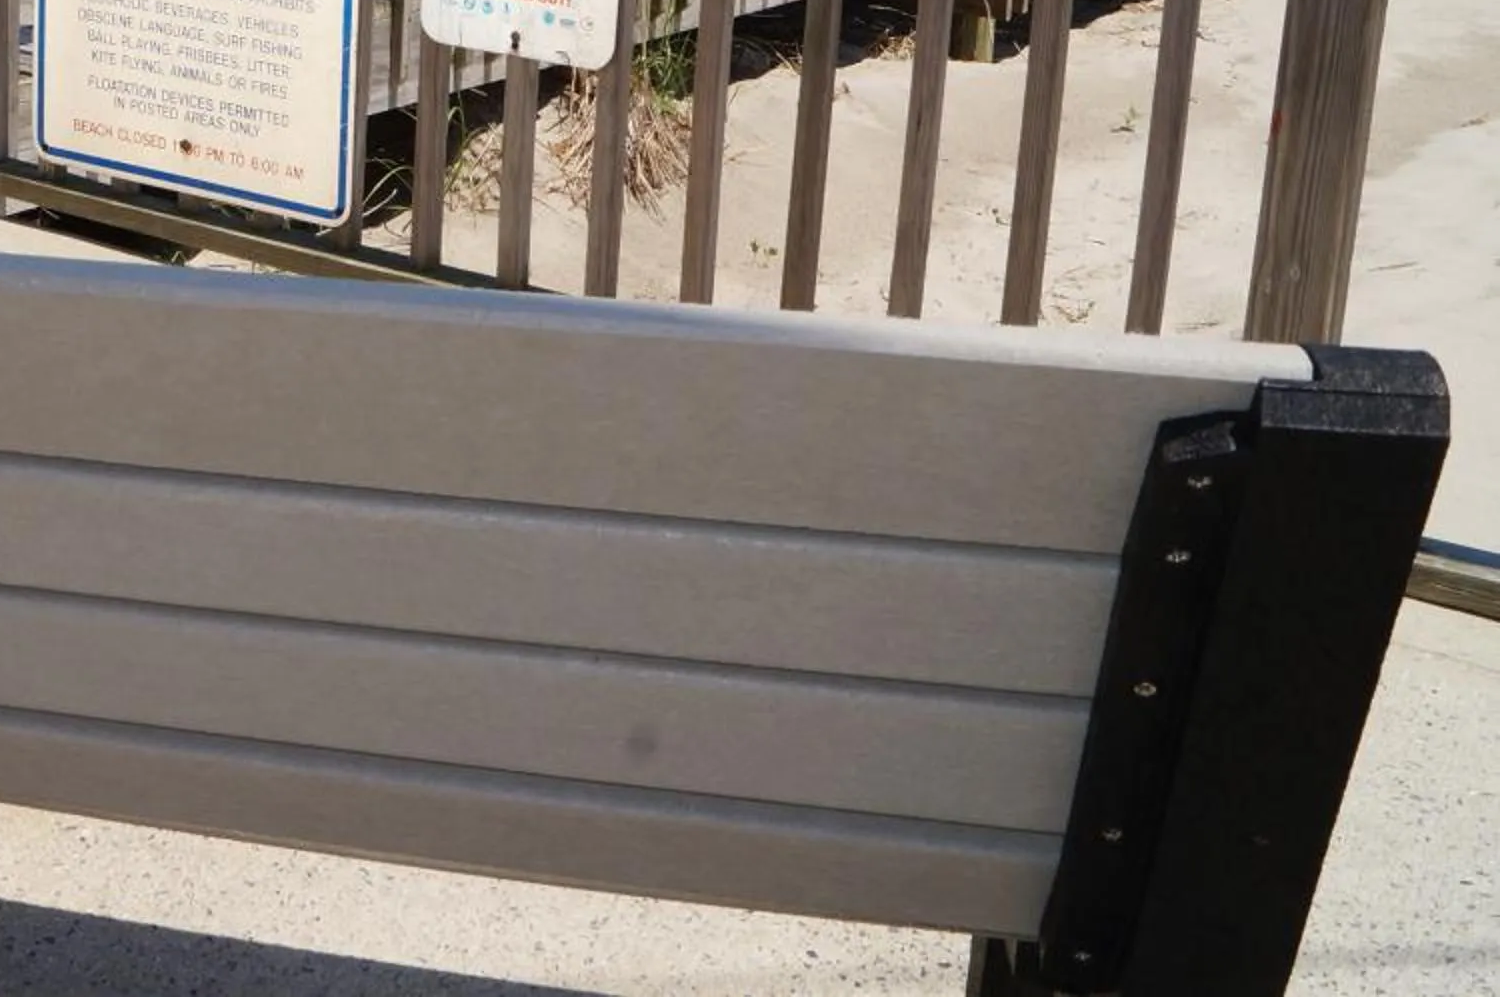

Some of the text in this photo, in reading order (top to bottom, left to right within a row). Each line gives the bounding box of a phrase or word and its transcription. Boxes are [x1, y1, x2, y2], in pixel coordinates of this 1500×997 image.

[87, 28, 117, 46] BALL
[213, 29, 246, 49] SURF
[90, 48, 118, 66] KITE
[169, 63, 224, 87] ANIMALS
[228, 74, 248, 91] OR
[251, 79, 290, 101] FIRES
[114, 94, 262, 138] IN POSTED AREAS ONLY
[161, 89, 214, 113] DEVICES
[218, 100, 290, 129] PERMITTED
[71, 117, 113, 137] BEACH
[117, 127, 167, 150] CLOSED
[205, 146, 226, 163] PM
[229, 150, 246, 168] TO
[284, 163, 305, 180] AM
